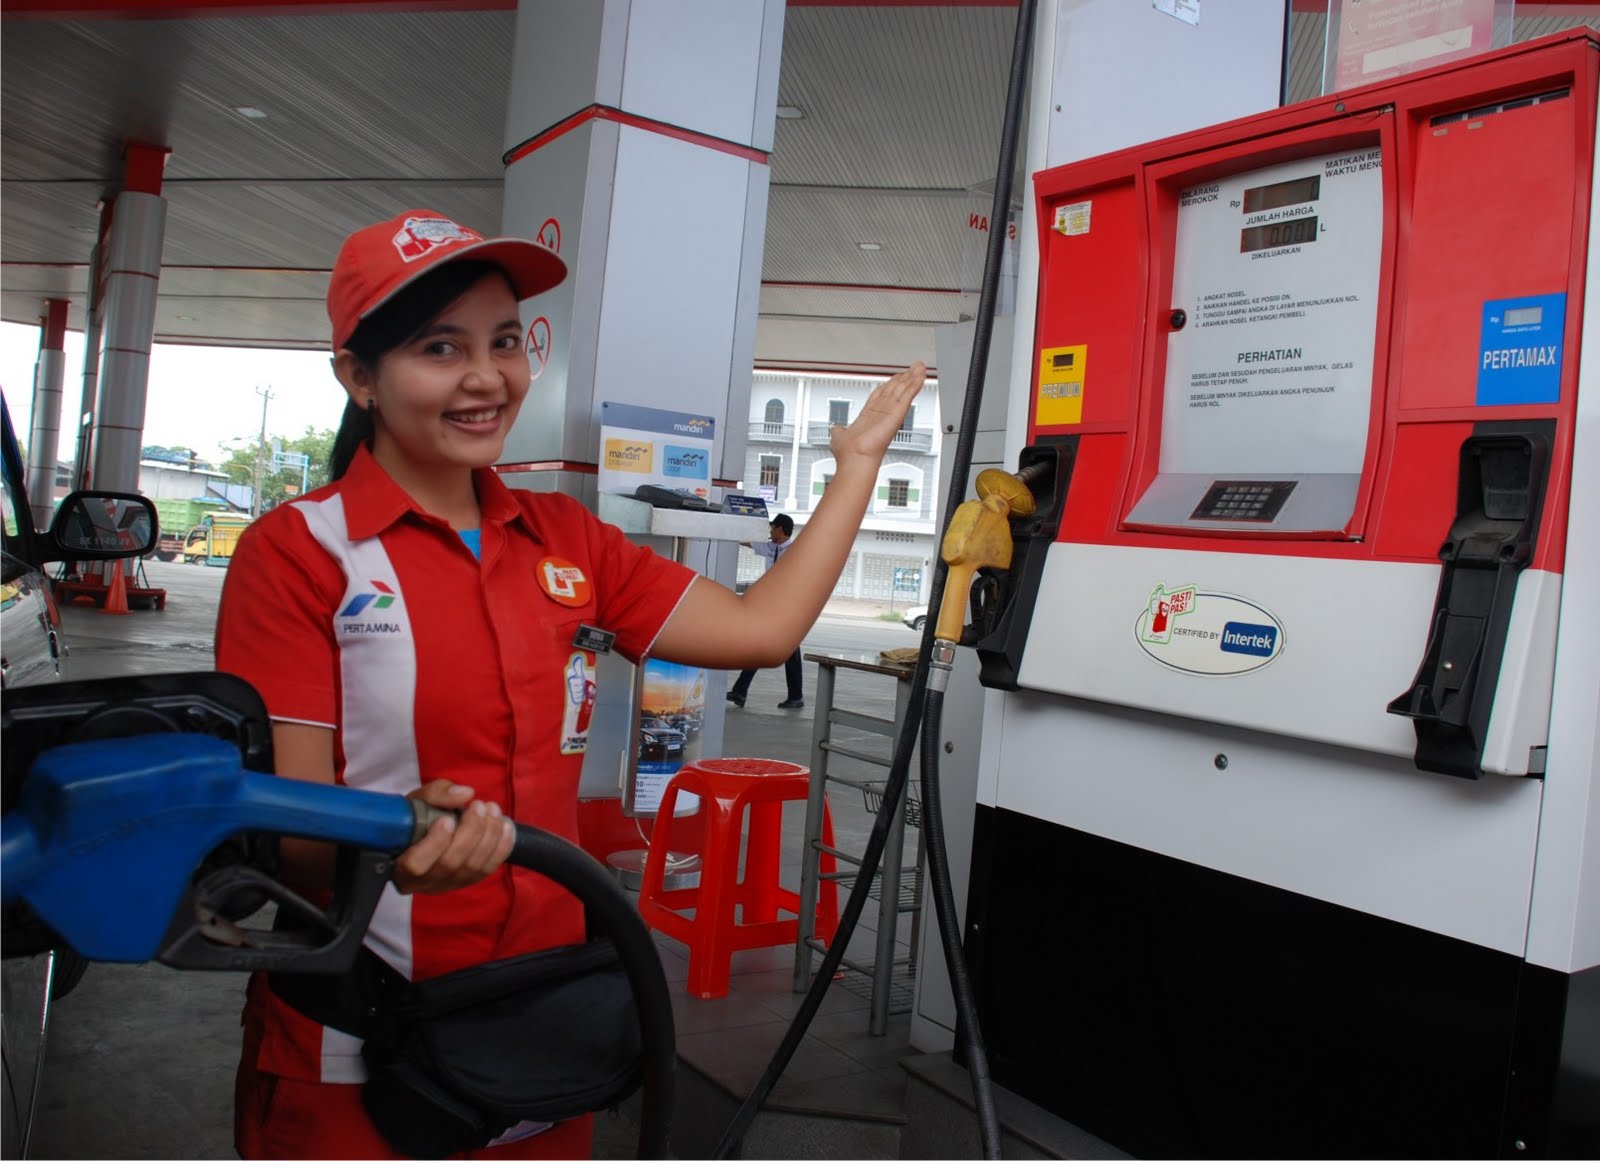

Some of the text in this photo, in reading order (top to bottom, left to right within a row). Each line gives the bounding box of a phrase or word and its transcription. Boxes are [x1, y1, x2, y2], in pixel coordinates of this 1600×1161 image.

[1325, 154, 1365, 169] MATIKAN
[1325, 165, 1357, 178] WAKTU
[1181, 185, 1219, 199] DILARANG
[1181, 194, 1219, 207] MEROKOK
[1230, 200, 1241, 208] Rp
[1245, 206, 1314, 225] JUMLAH HARGA
[1320, 223, 1326, 232] L
[1251, 247, 1302, 260] DIKELUARKAN
[1203, 293, 1226, 301] ANGKAT
[1203, 302, 1228, 310] NAIKKAN
[1228, 299, 1250, 307] HANDEL
[1261, 295, 1280, 303] POSISI
[1203, 311, 1226, 319] TUNGGU
[1248, 305, 1268, 313] ANGKA
[1276, 302, 1296, 311] LAYAR
[1296, 296, 1344, 307] MENUNJUKKAN
[1202, 319, 1228, 328] ARAHKAN
[1229, 317, 1248, 325] NOSEL
[1237, 348, 1302, 363] PERHATIAN
[1483, 345, 1557, 370] PERTAMAX
[1191, 372, 1217, 380] SEBELUM
[1230, 369, 1258, 377] SESUDAH
[1258, 366, 1303, 375] PENGELUARAN
[1331, 361, 1354, 370] GELAS
[1216, 391, 1237, 399] MINYAK
[1238, 390, 1279, 398] DIKELUARKAN
[1302, 386, 1335, 394] PENUNJUK
[674, 423, 703, 434] mandiri
[609, 450, 640, 461] mandiri
[667, 457, 697, 467] mandiri
[1170, 591, 1193, 604] PASTI
[1169, 602, 1188, 614] PAS!
[343, 623, 401, 634] PERTAMINA
[1173, 627, 1209, 639] CERTIFIED
[1209, 632, 1220, 640] BY
[1224, 629, 1273, 649] Intertek
